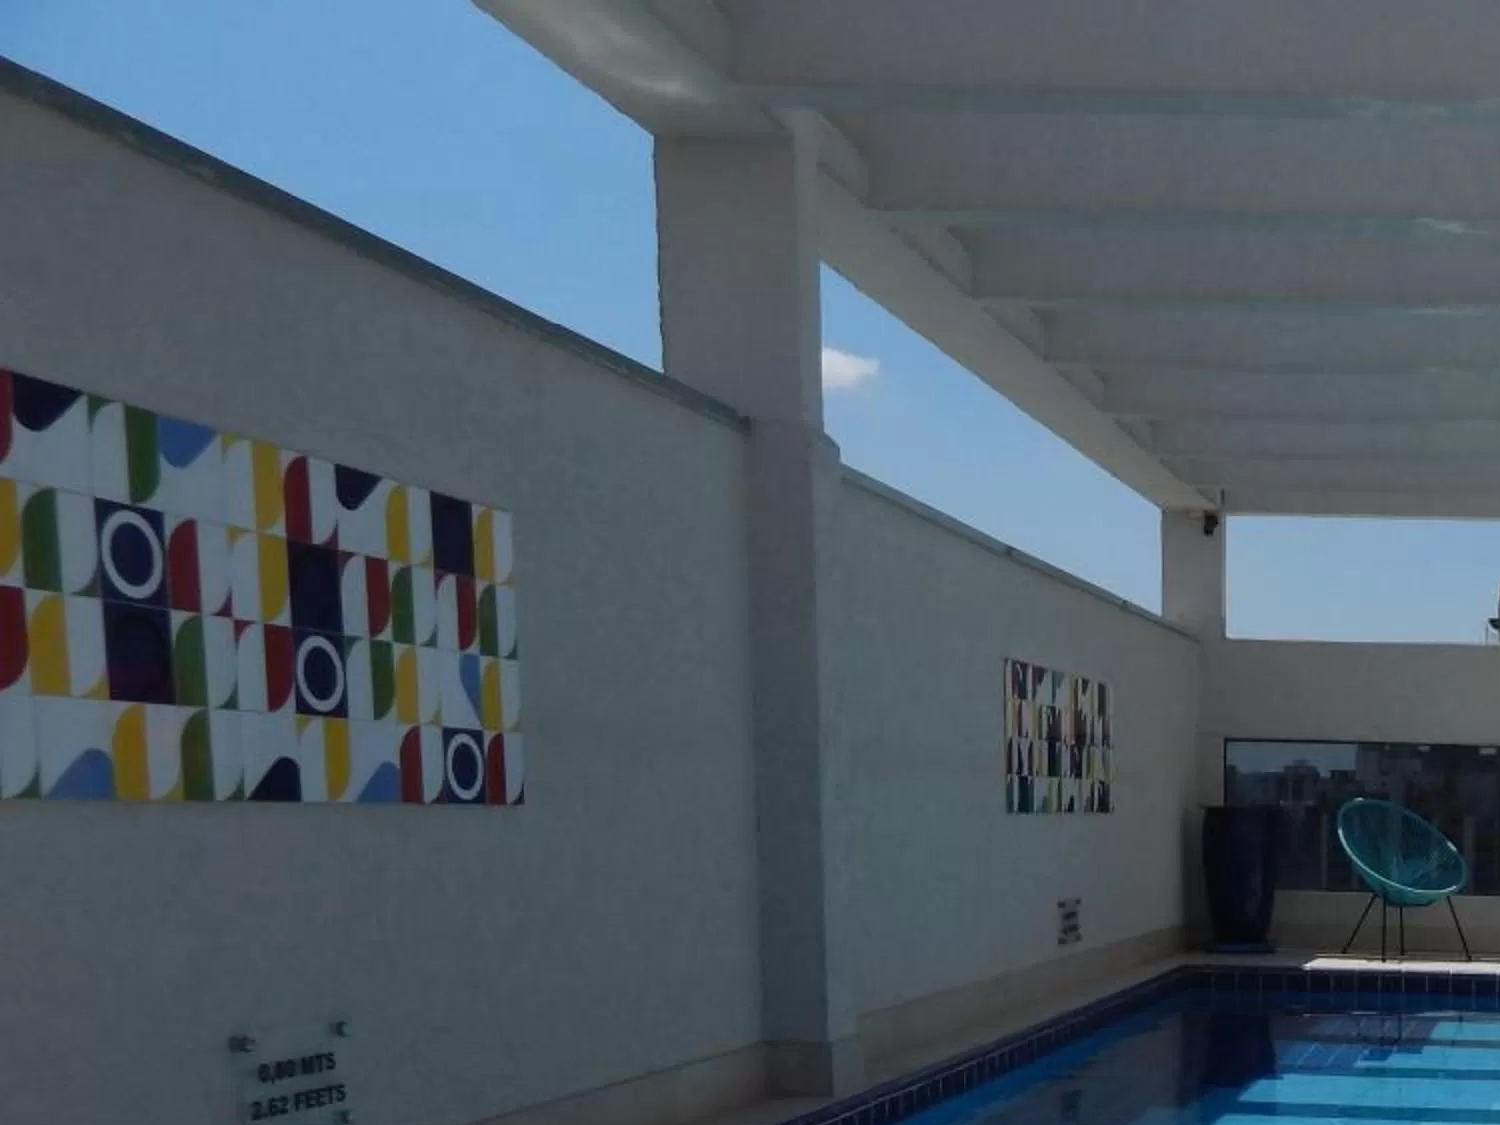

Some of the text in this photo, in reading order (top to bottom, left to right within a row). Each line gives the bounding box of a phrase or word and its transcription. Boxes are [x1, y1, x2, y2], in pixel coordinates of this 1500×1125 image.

[300, 1052, 336, 1074] MTS
[251, 1084, 347, 1121] 2.62 FEETS
